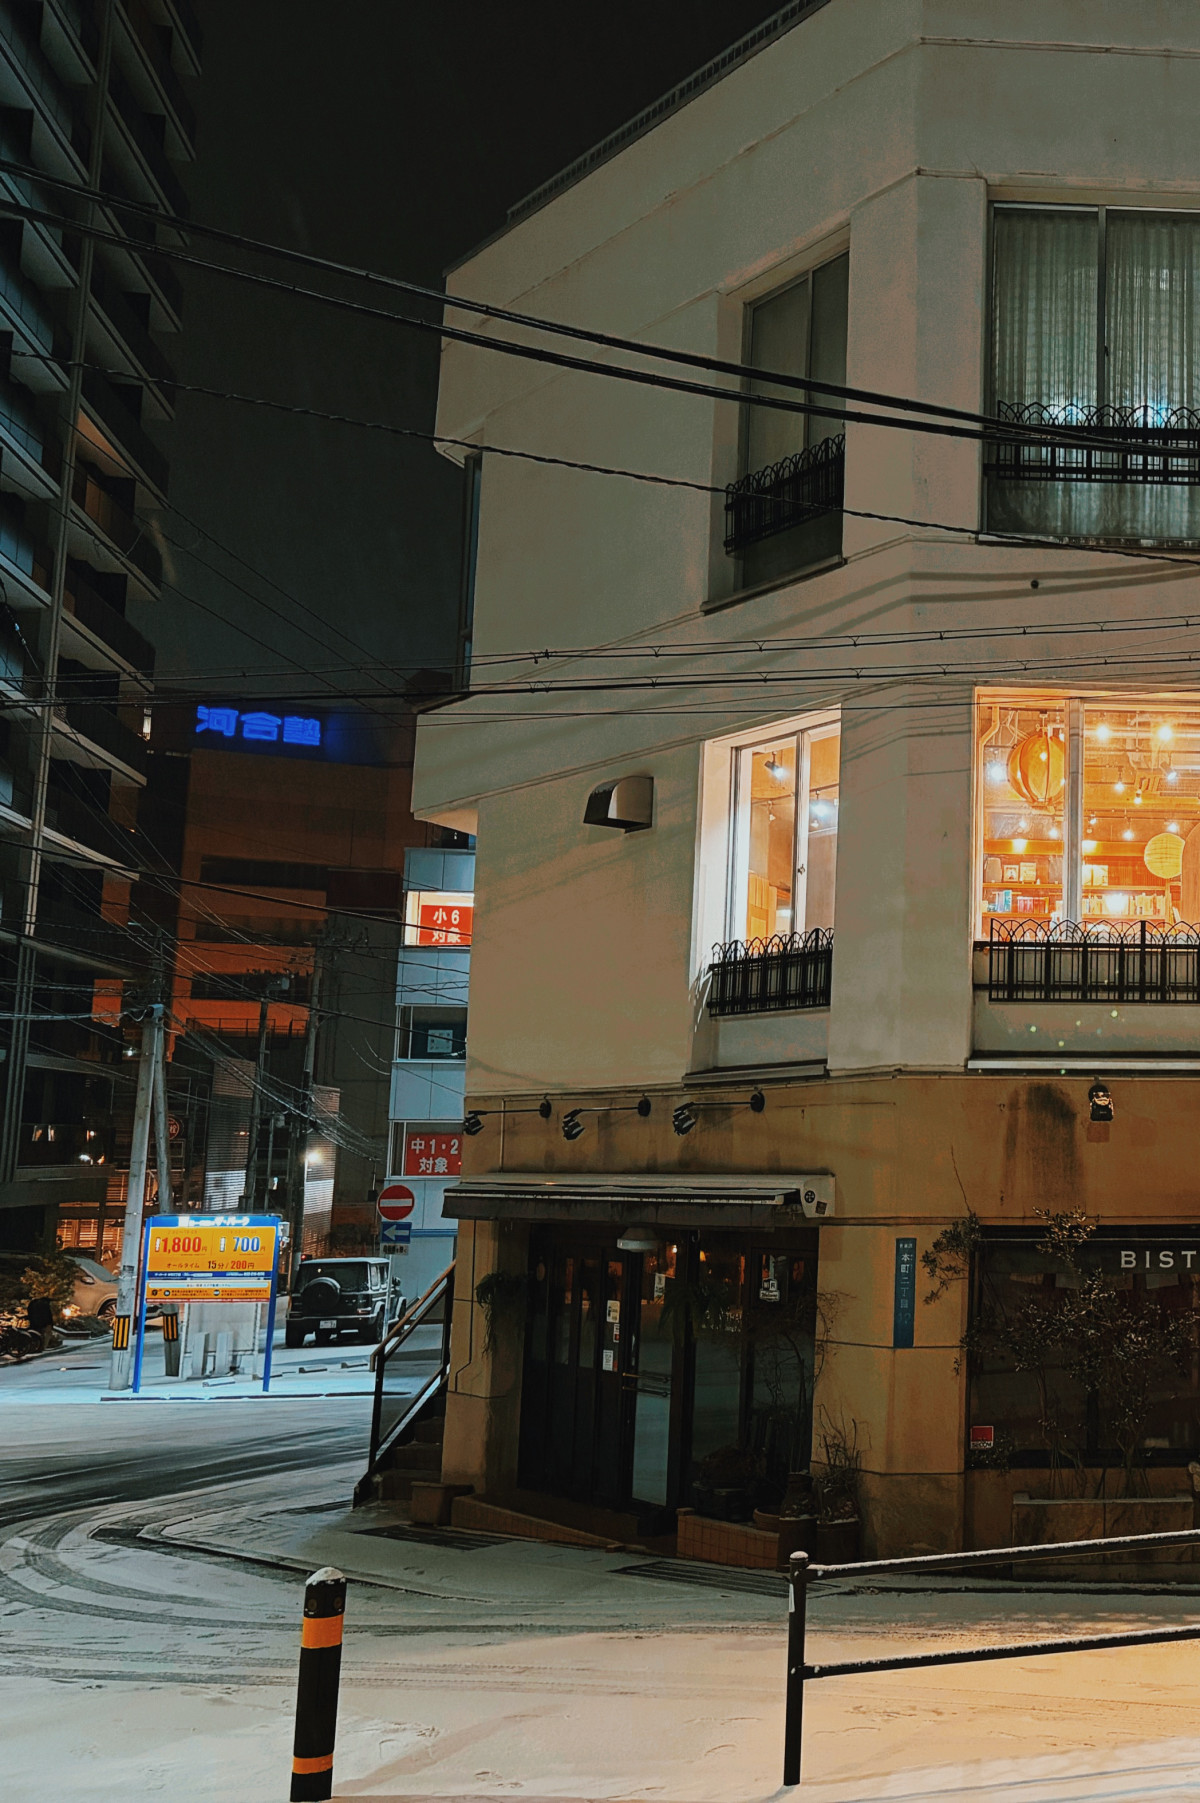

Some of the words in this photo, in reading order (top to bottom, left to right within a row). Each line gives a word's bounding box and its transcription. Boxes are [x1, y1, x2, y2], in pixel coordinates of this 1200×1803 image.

[196, 705, 321, 746] 河合塾
[418, 1156, 449, 1174] 対象
